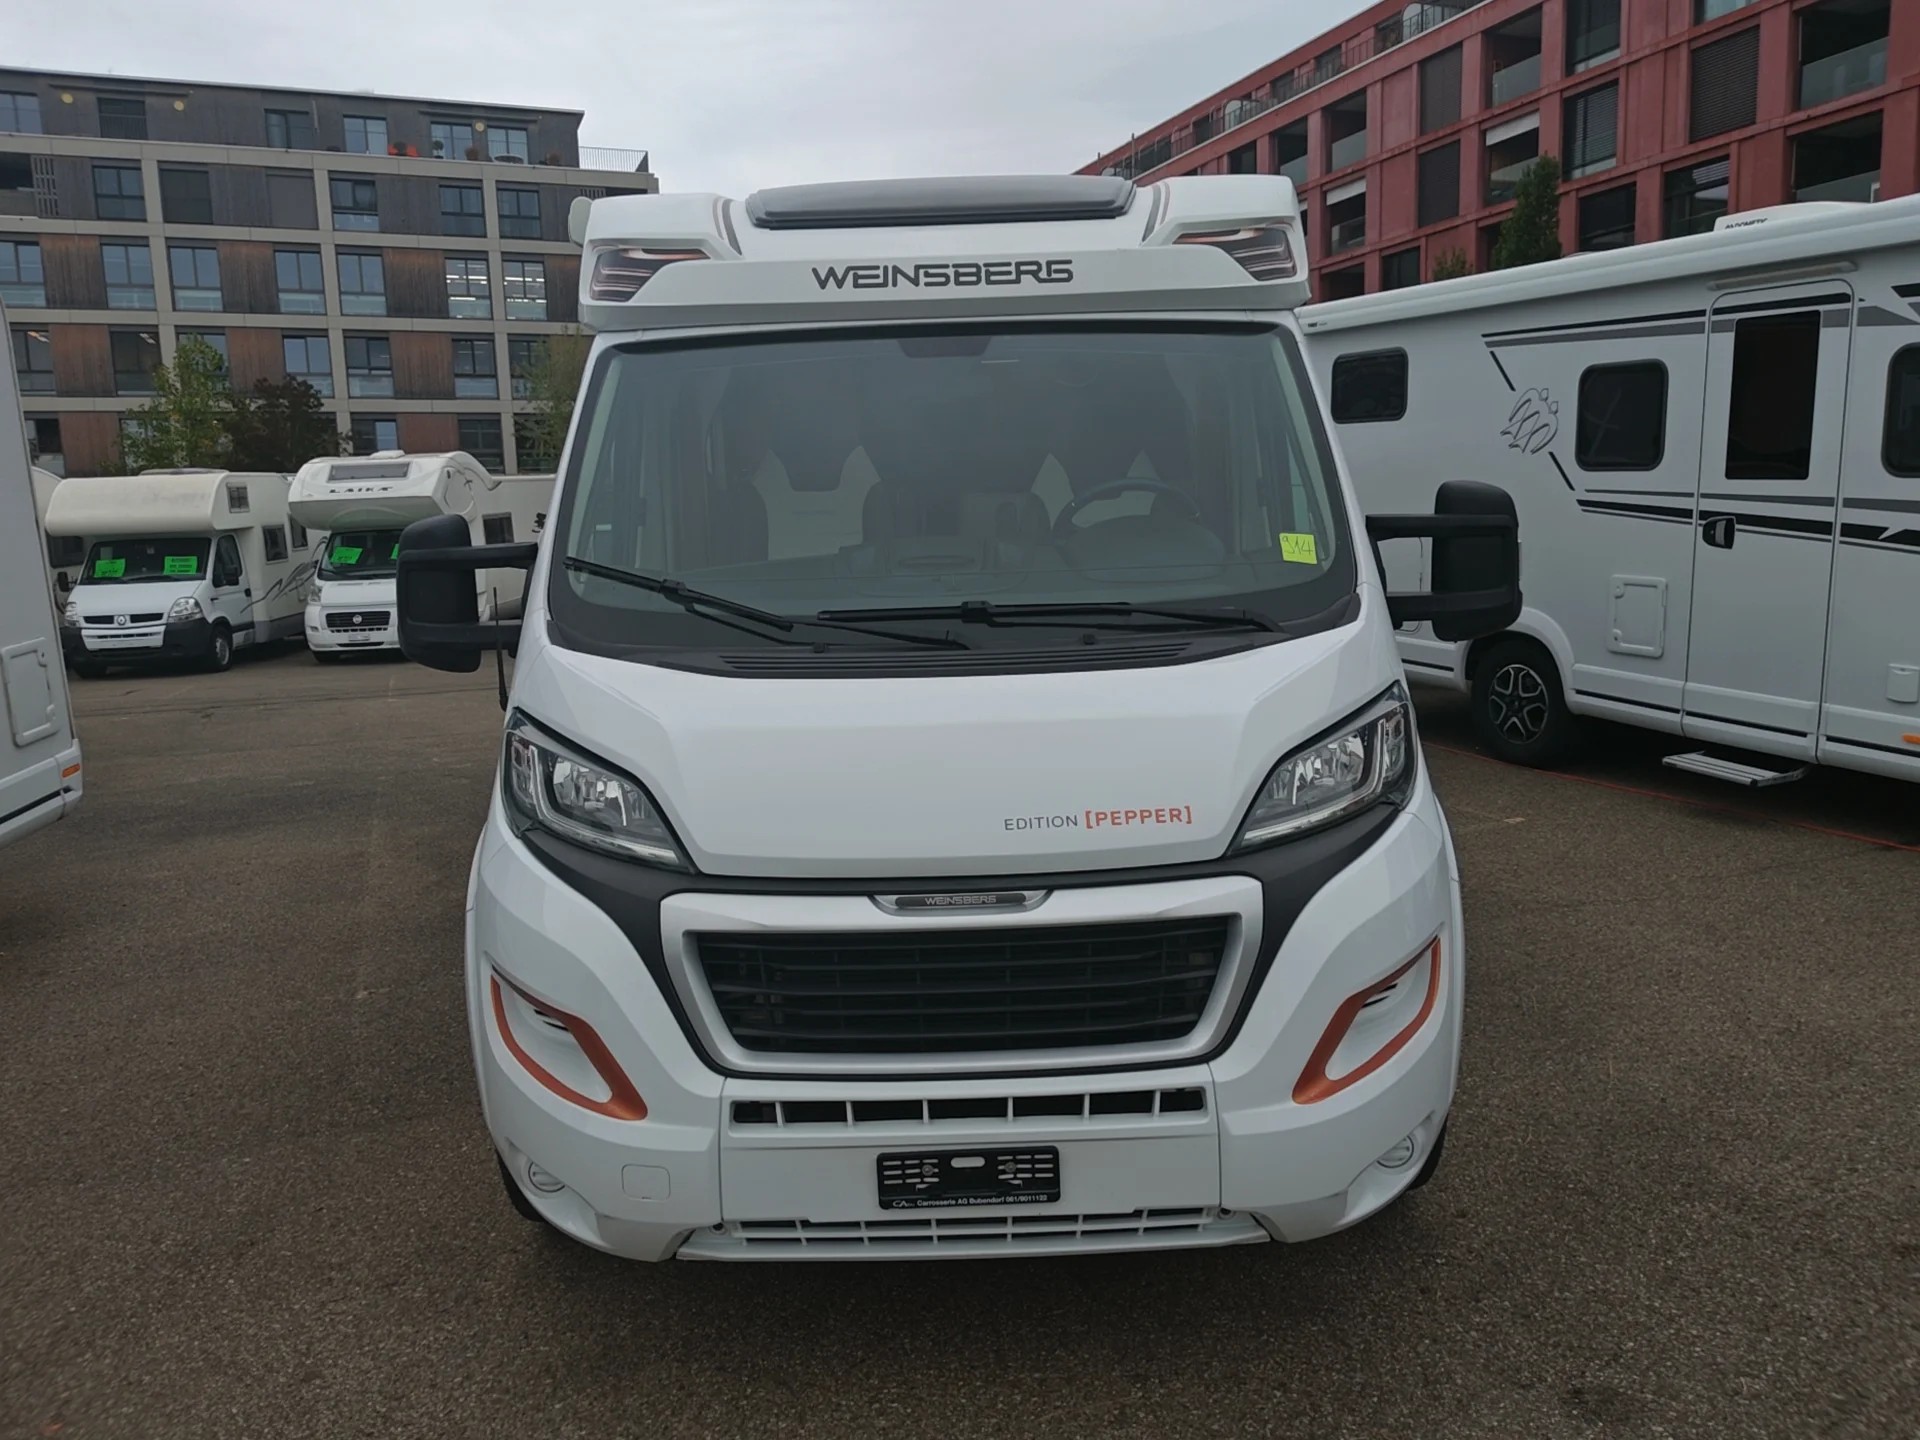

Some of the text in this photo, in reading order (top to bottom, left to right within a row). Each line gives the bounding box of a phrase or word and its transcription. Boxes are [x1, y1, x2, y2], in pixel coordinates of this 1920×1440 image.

[811, 259, 1074, 290] WEINSBERG
[1004, 806, 1192, 831] EDITION [PEPPER]
[925, 895, 997, 905] WEINSBERG
[917, 1199, 956, 1207] Carrosserie
